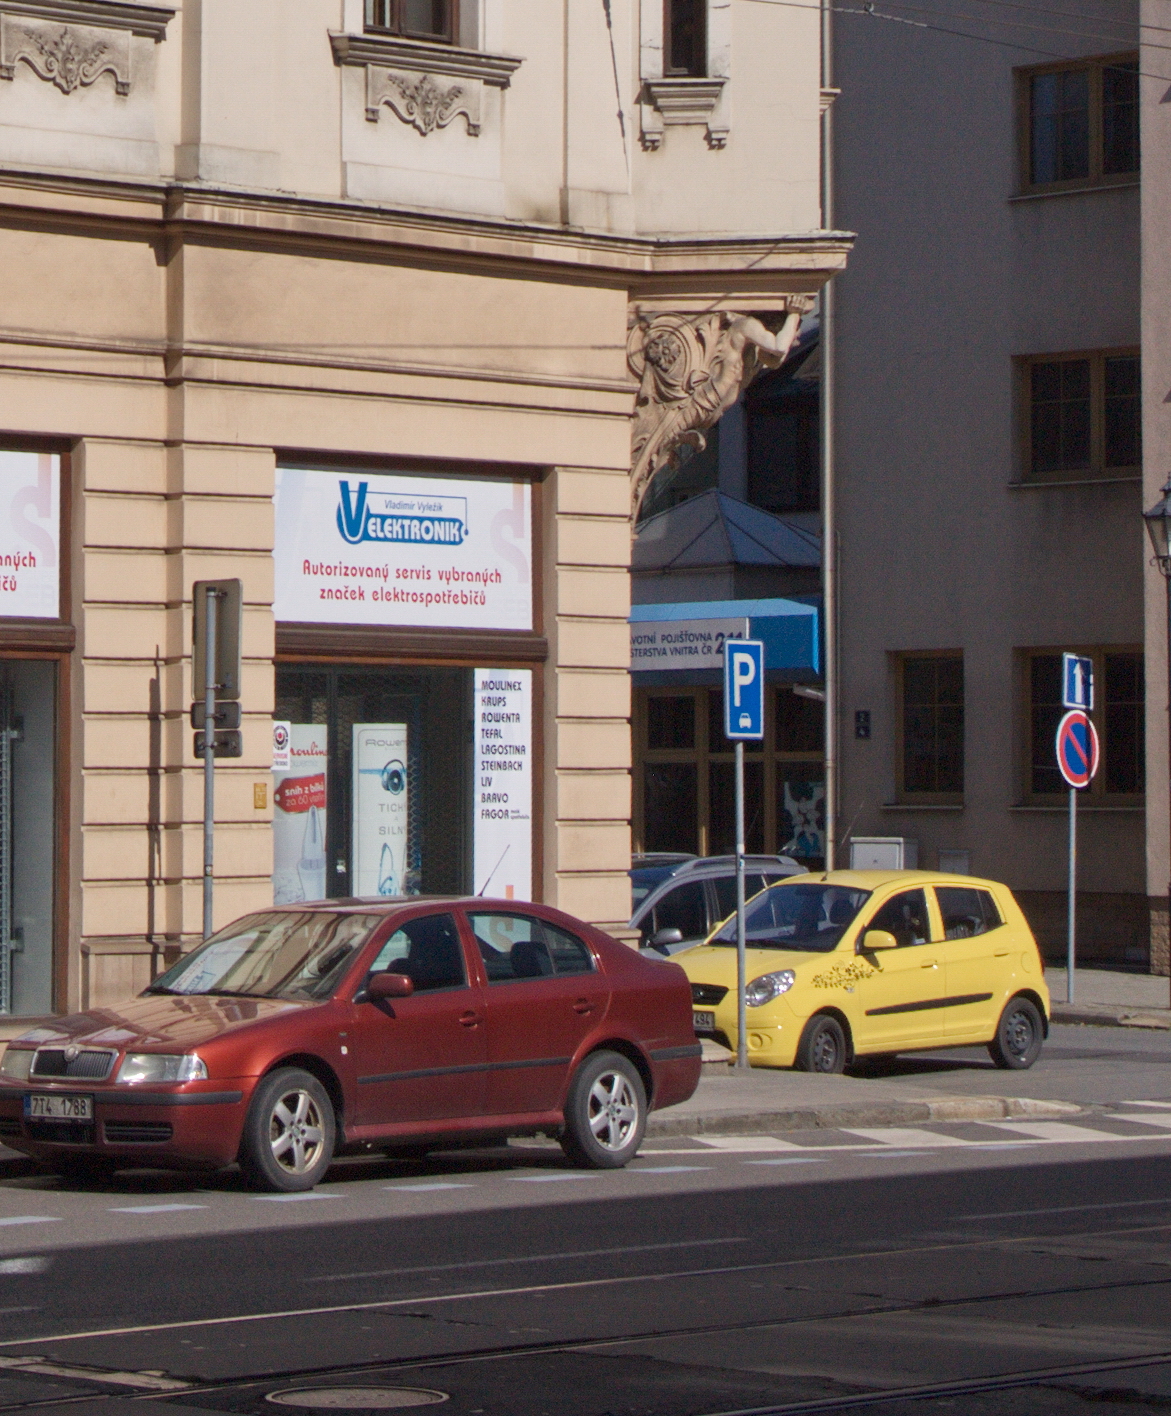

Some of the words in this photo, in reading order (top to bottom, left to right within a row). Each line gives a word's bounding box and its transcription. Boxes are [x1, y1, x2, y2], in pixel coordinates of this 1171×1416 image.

[303, 559, 389, 583] Autorizovaný
[395, 565, 432, 581] servis
[438, 566, 502, 587] vybraných
[319, 585, 365, 602] značek
[371, 587, 486, 607] elektrospotřebičů
[661, 630, 712, 644] POJIŠŤOVNA
[670, 645, 698, 656] VNITRA
[701, 643, 712, 655] ČR
[733, 652, 756, 707] P
[481, 680, 522, 691] MOULINEX
[481, 696, 507, 707] KRUPS
[481, 712, 520, 723] ROWENTA
[481, 728, 503, 739] TEFAL
[481, 744, 526, 755] LAGOSTINA
[481, 760, 523, 771] STEINBACH
[481, 776, 493, 787] LIV
[481, 792, 509, 803] BRAVO
[481, 809, 510, 820] FAGOR
[32, 1097, 52, 1115] 7T4
[61, 1098, 86, 1116] 1788
